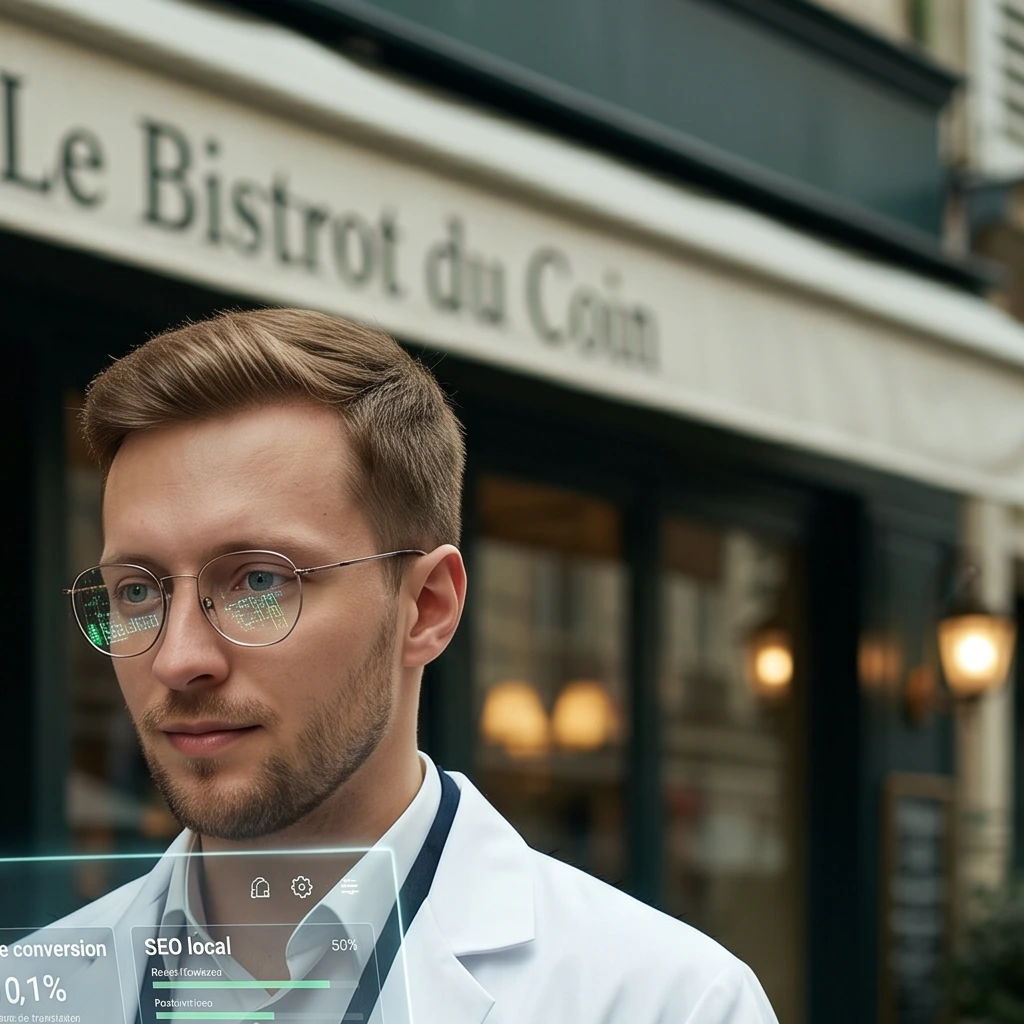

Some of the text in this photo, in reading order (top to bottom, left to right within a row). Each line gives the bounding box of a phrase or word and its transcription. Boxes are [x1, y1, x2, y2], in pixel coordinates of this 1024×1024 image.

[140, 114, 403, 300] Bistrot
[424, 213, 509, 333] du
[525, 245, 663, 375] Coin
[13, 939, 107, 958] conversion
[144, 936, 232, 956] SEO local
